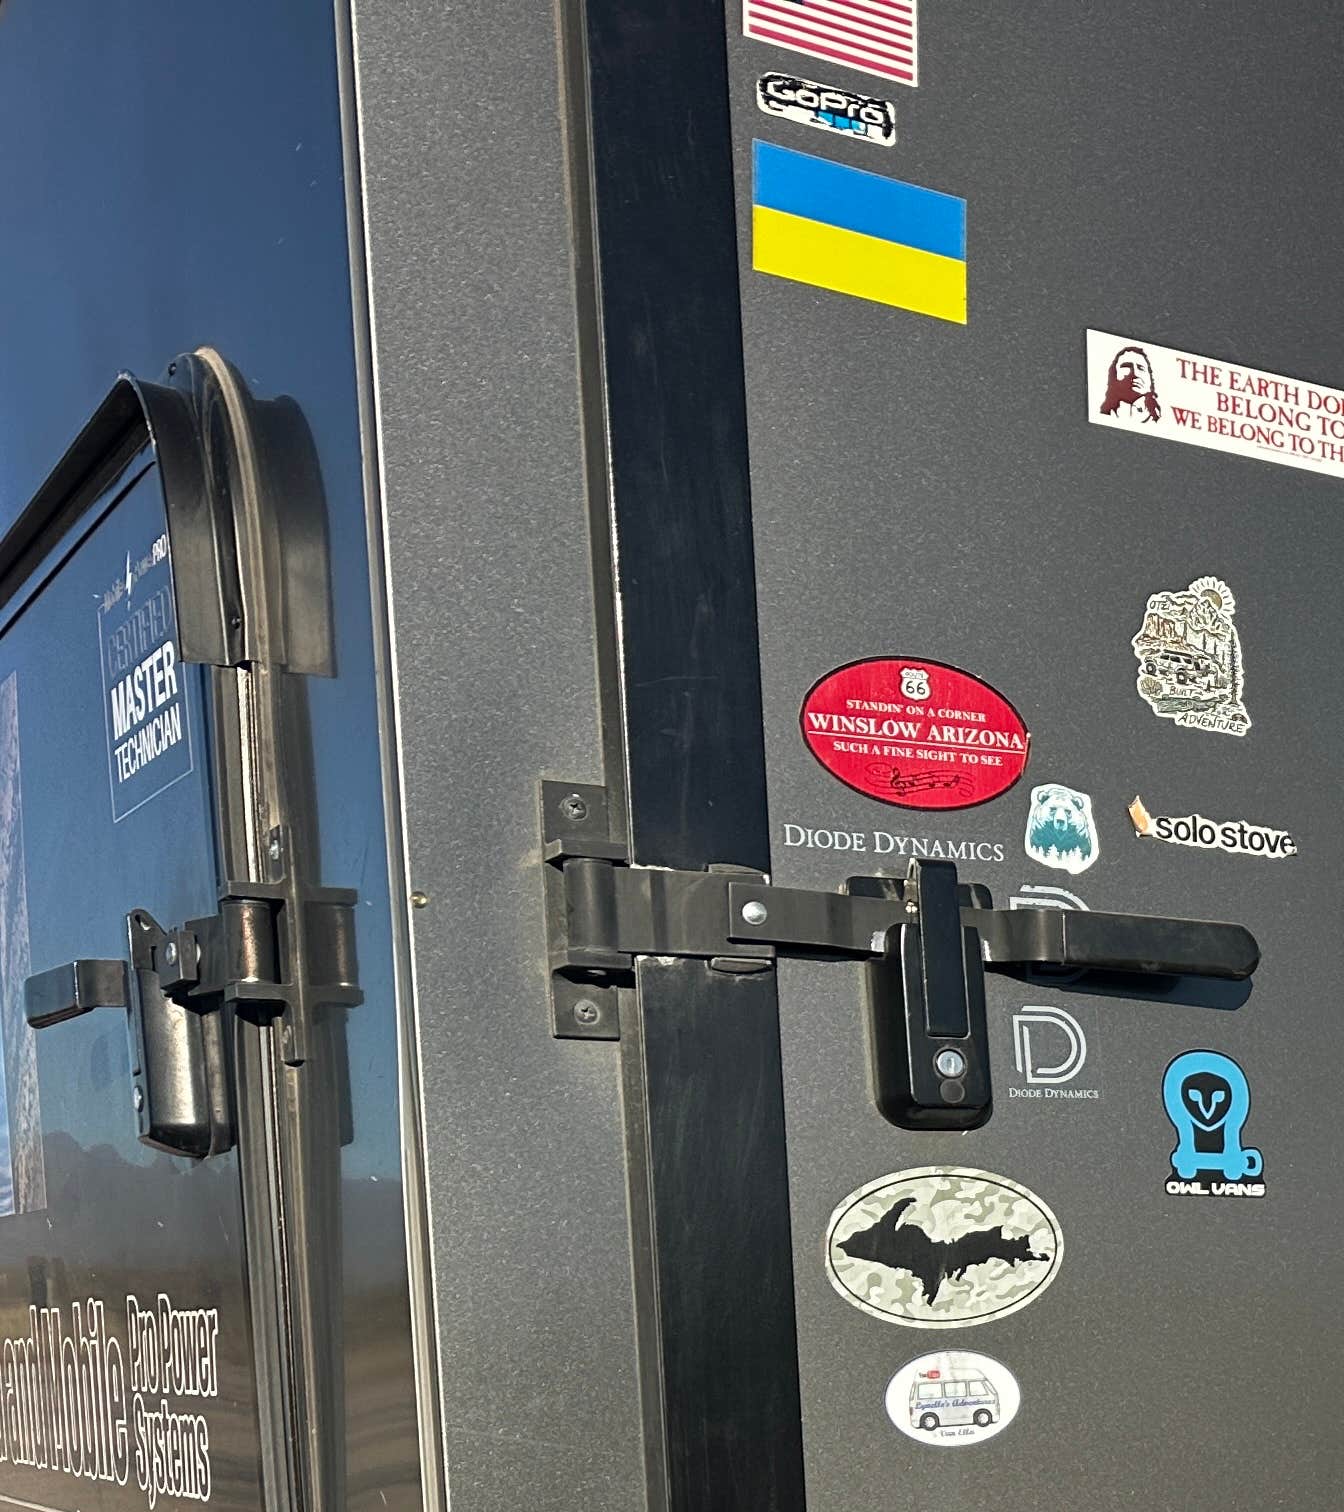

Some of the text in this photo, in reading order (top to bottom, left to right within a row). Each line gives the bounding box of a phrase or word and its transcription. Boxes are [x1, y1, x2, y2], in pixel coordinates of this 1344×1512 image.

[766, 80, 884, 124] GoPro
[1176, 357, 1222, 387] THE
[1229, 365, 1299, 405] EARTH
[1171, 406, 1202, 430] WE
[1207, 415, 1284, 448] BELONG
[1288, 433, 1315, 455] TO
[1216, 392, 1311, 431] BELONG
[111, 640, 178, 741] MASTER
[905, 681, 926, 696] 66
[846, 699, 986, 722] STANDIN' ON A CORNER
[1177, 712, 1246, 734] ADVENTURE
[114, 703, 182, 783] TECHNICIAN
[808, 713, 1024, 749] WINSLOW ARIZONA
[833, 741, 1003, 766] SUCH A FINE SIGHT TO SEE
[784, 824, 1004, 861] DIODE DYNAMICS
[1155, 816, 1295, 853] solo stove
[1008, 1087, 1099, 1099] DIODE DYNAMICS
[1166, 1181, 1265, 1196] OWL VANS
[127, 1293, 218, 1397] Pro Power
[0, 1298, 129, 1486] and Mobile
[133, 1392, 211, 1510] Systems
